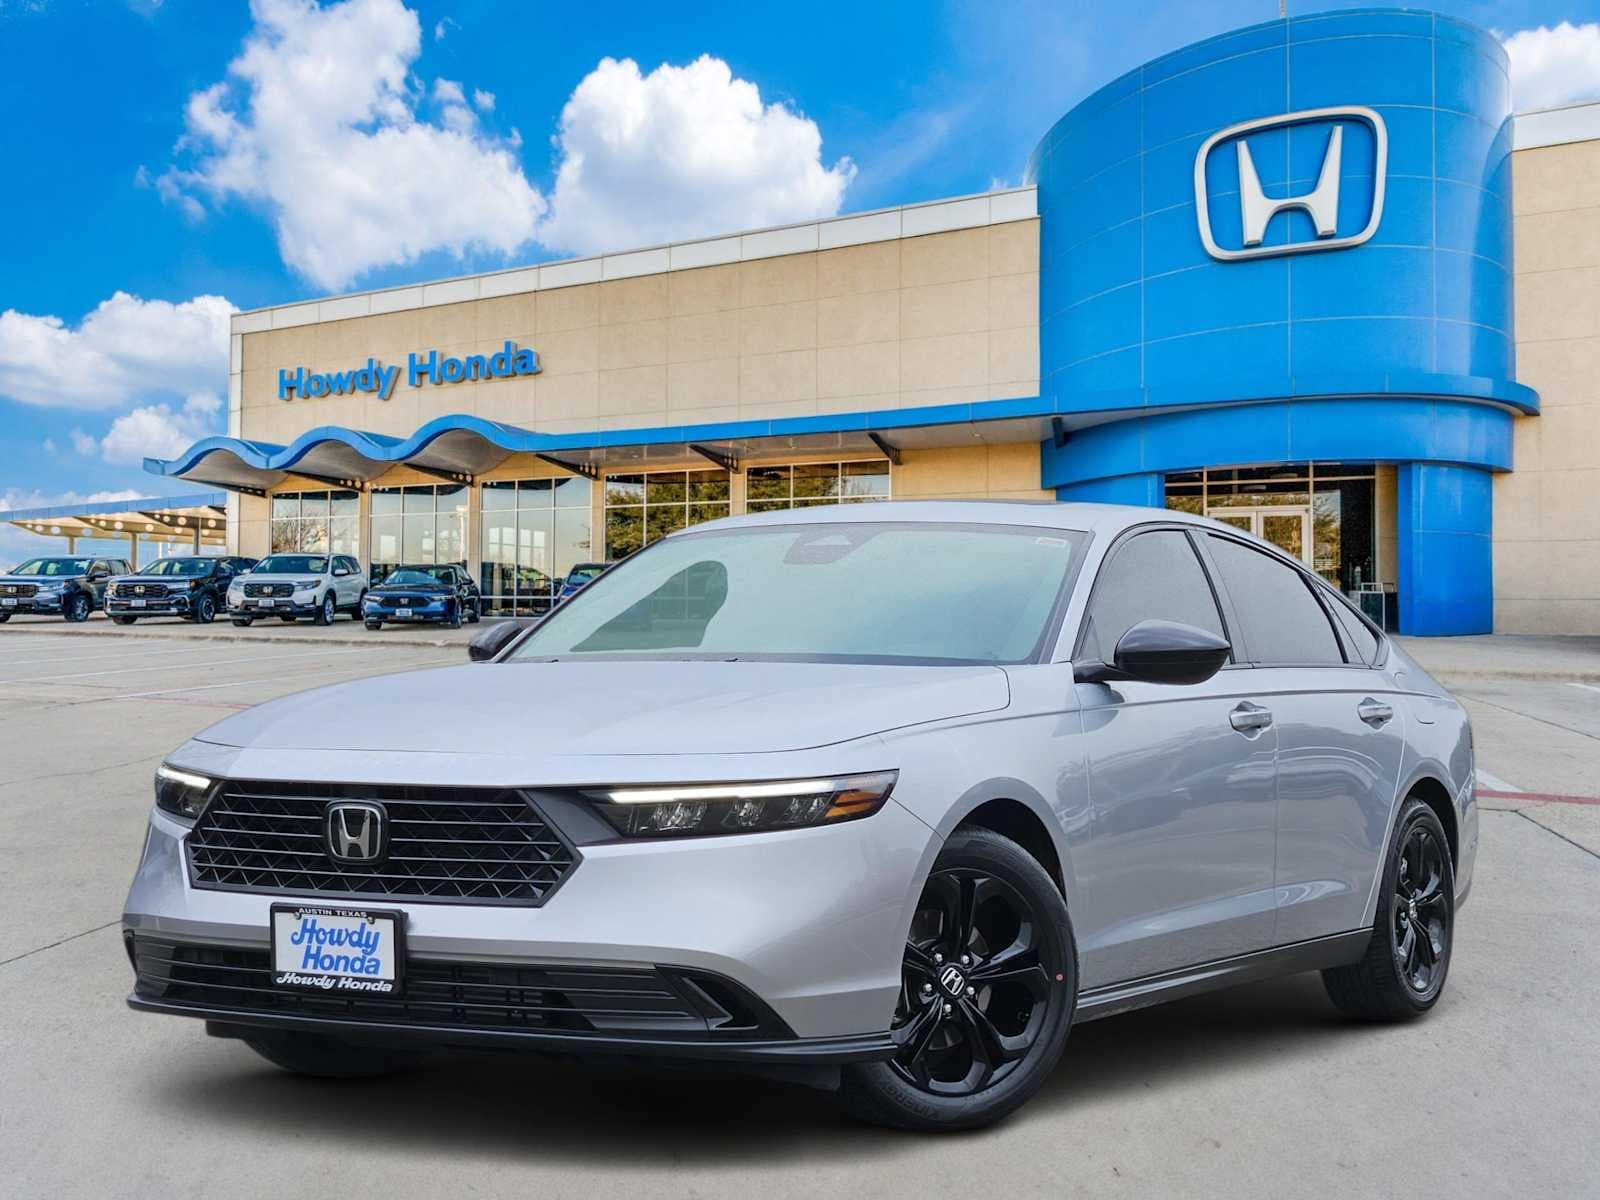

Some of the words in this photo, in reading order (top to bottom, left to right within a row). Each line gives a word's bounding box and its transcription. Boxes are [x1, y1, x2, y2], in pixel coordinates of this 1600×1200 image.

[278, 358, 401, 401] Howdy
[408, 341, 542, 388] Honda
[299, 907, 332, 916] AUSTIN
[334, 910, 368, 918] TEXAS
[290, 918, 380, 955] Howdy
[302, 945, 381, 975] Honda
[276, 972, 335, 989] Howdy
[337, 977, 393, 992] Honda
